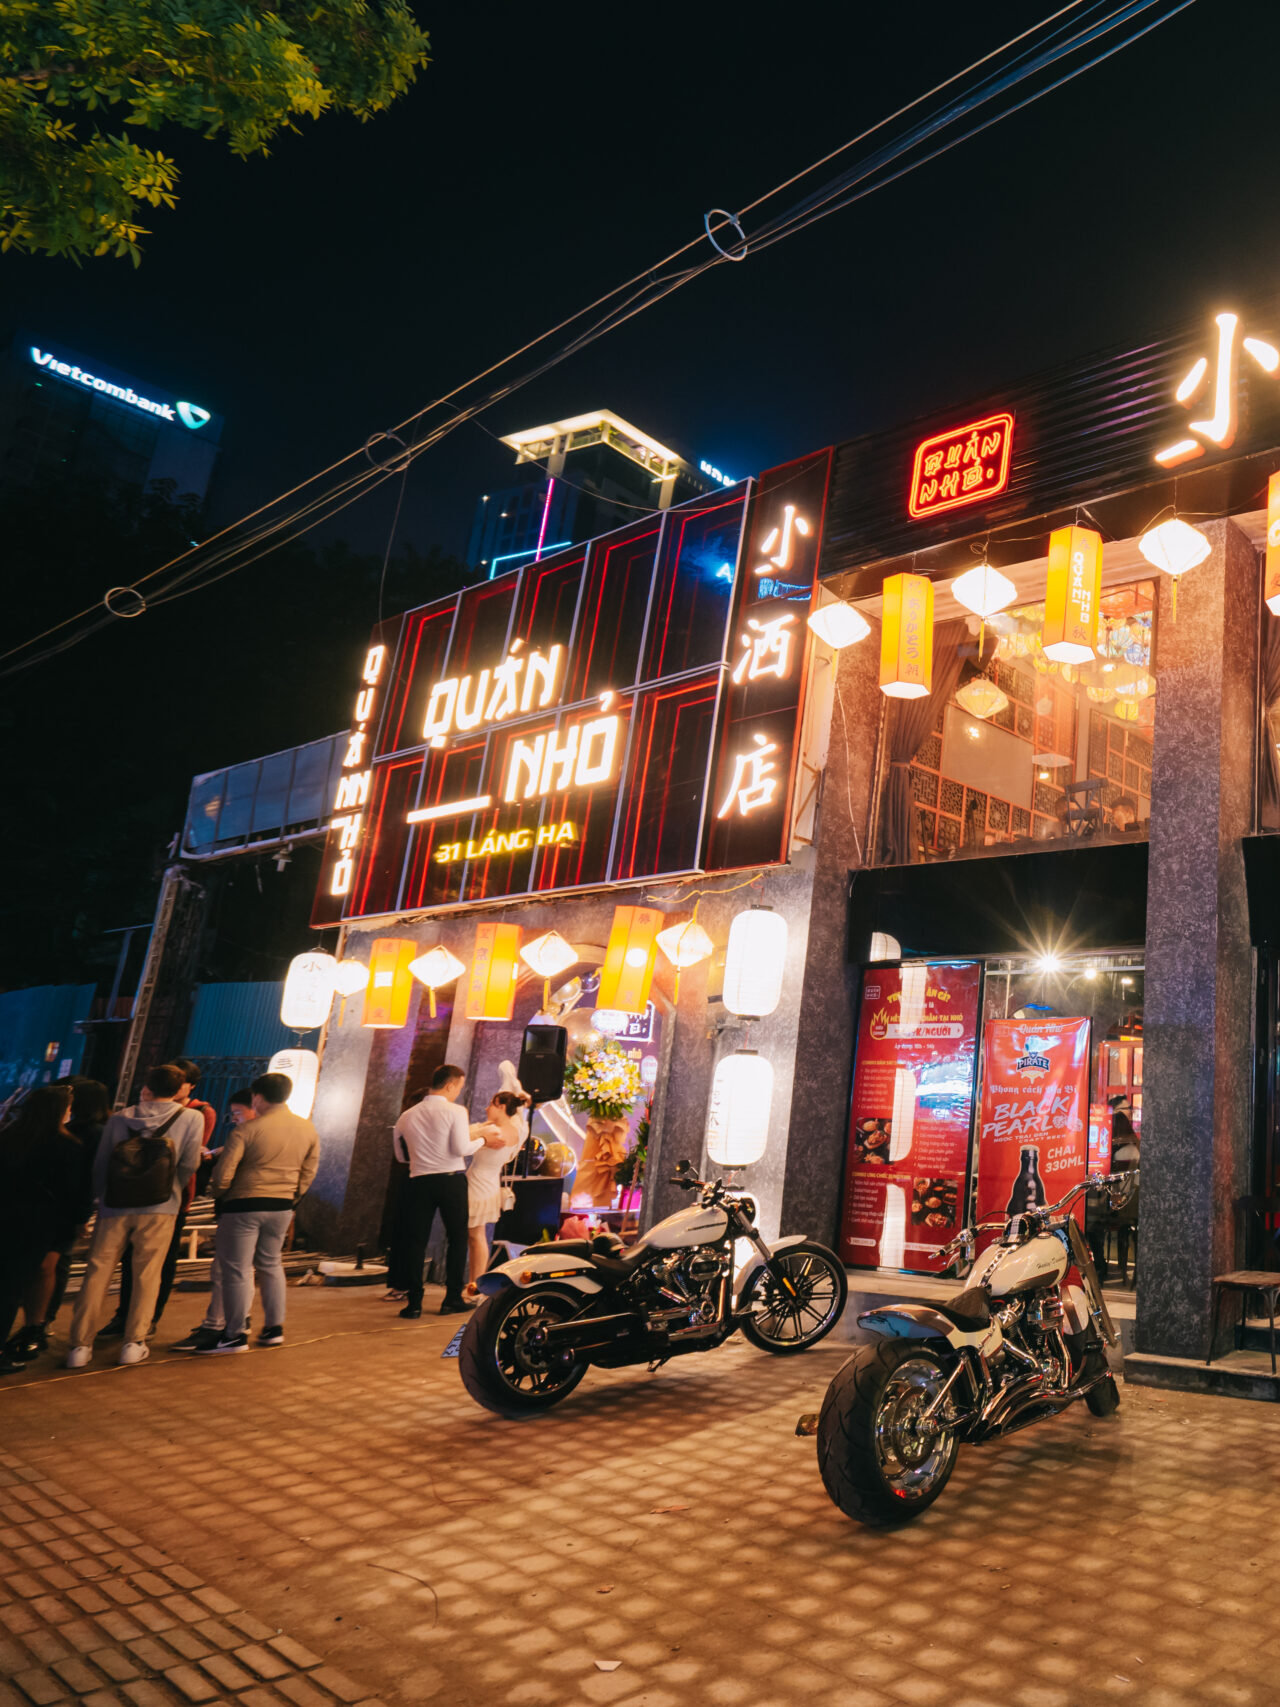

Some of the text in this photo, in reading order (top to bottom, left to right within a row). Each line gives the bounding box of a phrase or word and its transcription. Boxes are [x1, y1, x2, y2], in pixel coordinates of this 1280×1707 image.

[31, 347, 176, 421] Vietcombank
[423, 638, 562, 748] QUÁN
[505, 691, 619, 802] NHỎ
[435, 843, 461, 863] 31
[466, 829, 531, 859] LÁNG
[1019, 1057, 1048, 1068] PIRATE
[994, 1096, 1070, 1121] BLACK
[982, 1115, 1053, 1139] PEARL
[1045, 1155, 1084, 1173] 330ML
[1048, 1145, 1076, 1159] CHAI
